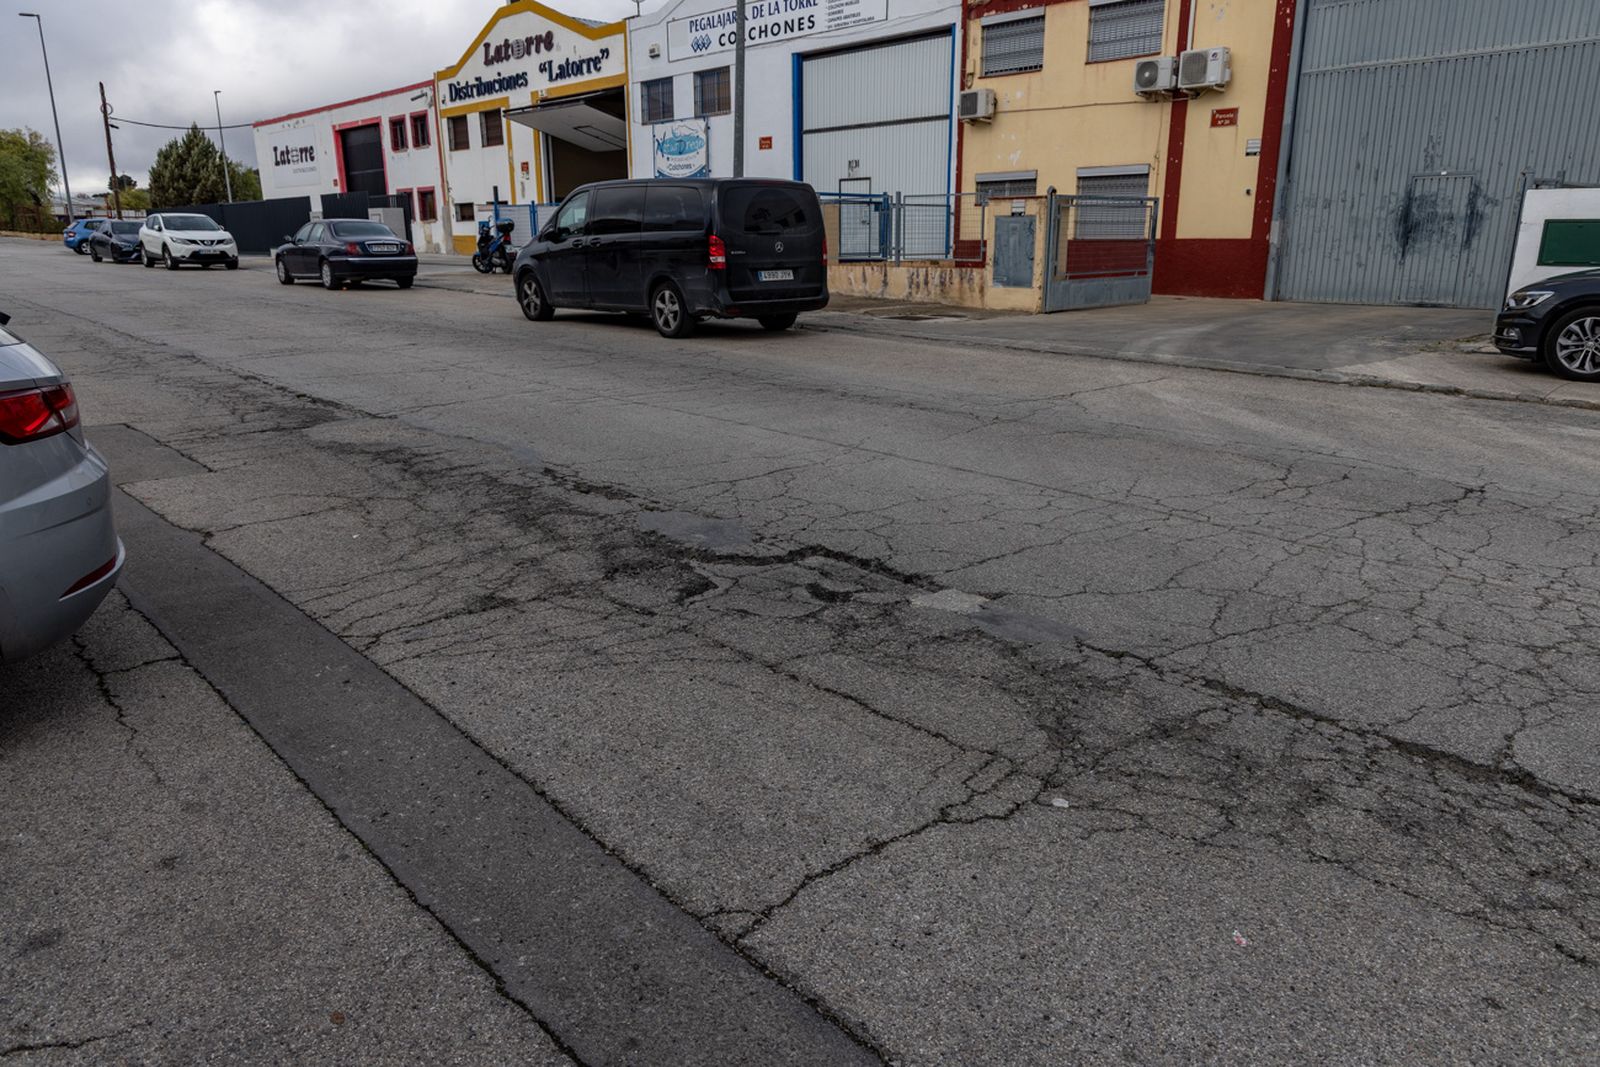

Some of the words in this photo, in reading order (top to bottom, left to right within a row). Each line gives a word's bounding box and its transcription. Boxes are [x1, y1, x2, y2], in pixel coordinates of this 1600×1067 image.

[690, 10, 749, 33] PEGALAJAR
[752, 4, 765, 19] DE
[768, 1, 780, 16] LA
[718, 14, 816, 47] COCHONES
[483, 30, 554, 67] Latorre
[448, 71, 529, 102] Distribuciones
